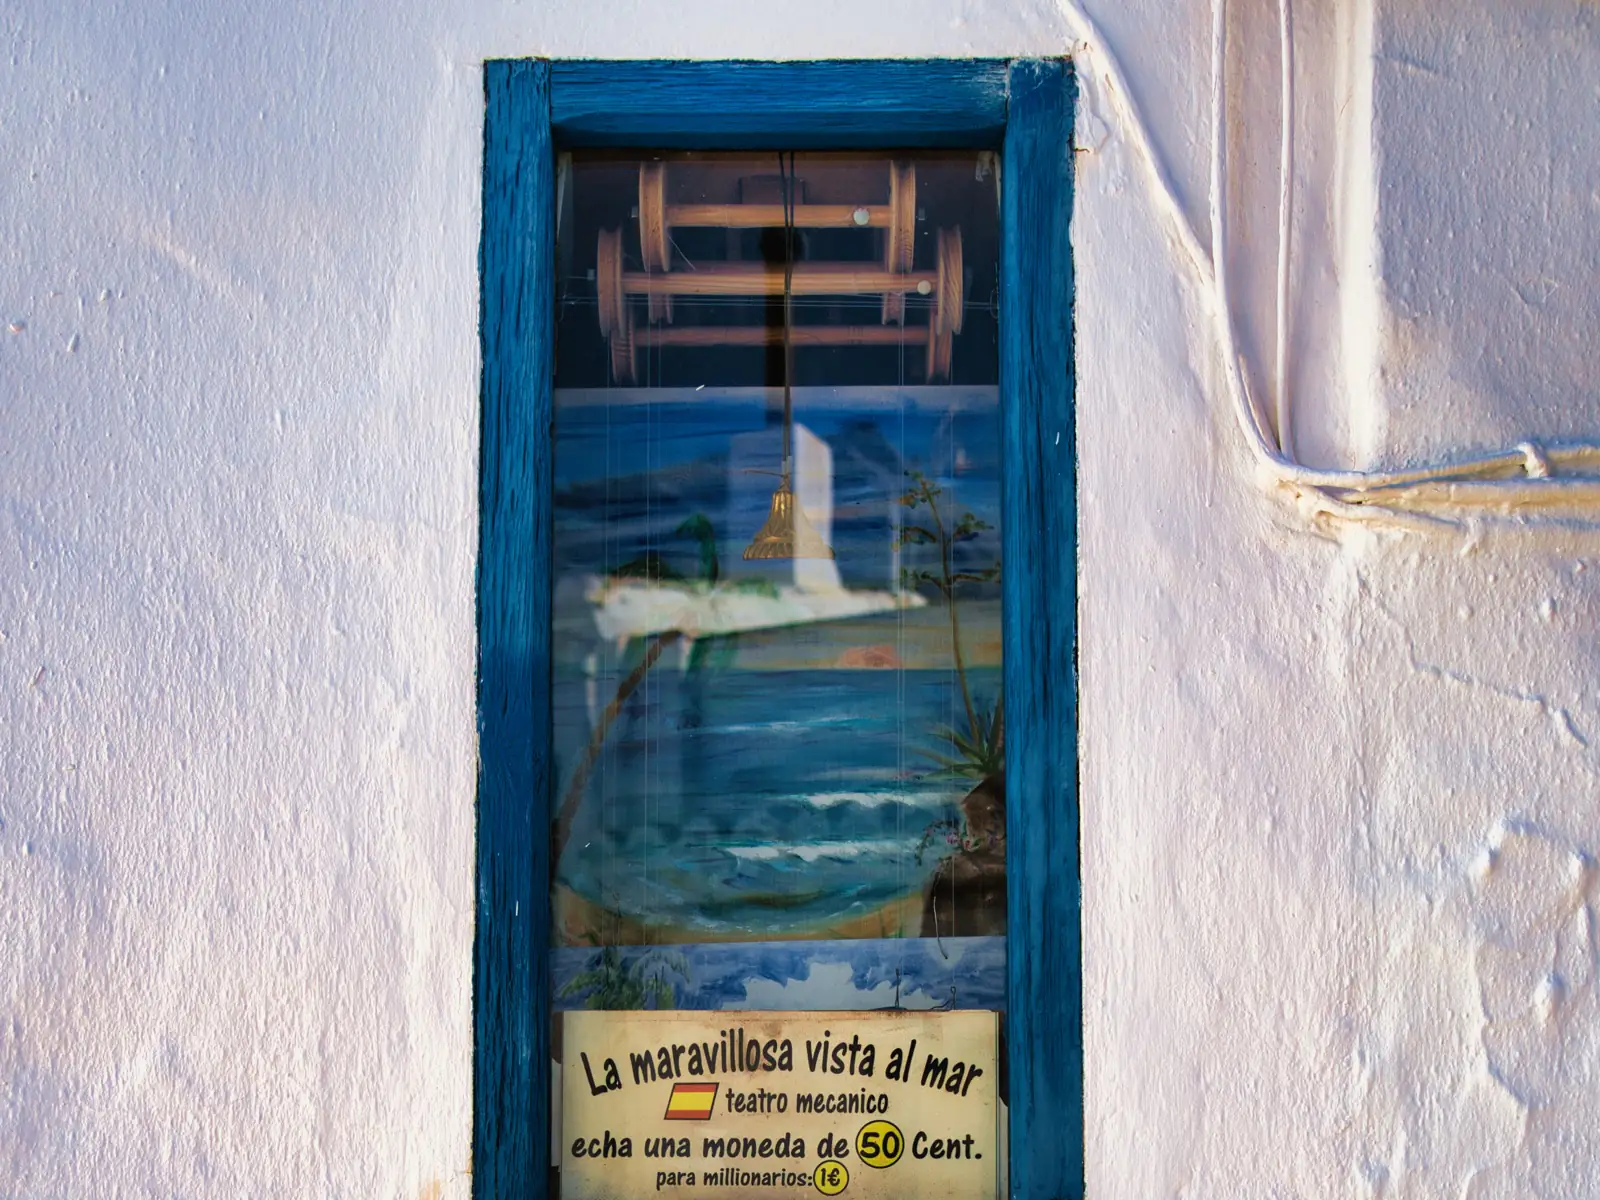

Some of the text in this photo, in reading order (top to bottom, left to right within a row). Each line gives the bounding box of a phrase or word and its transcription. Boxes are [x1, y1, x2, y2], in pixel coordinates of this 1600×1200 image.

[581, 1028, 983, 1096] La maravillosa vista al mar
[726, 1088, 888, 1113] teatro mecanico
[572, 1131, 982, 1159] echa una moneda de 50 Cent.
[657, 1168, 840, 1191] para millionarios: 1€
